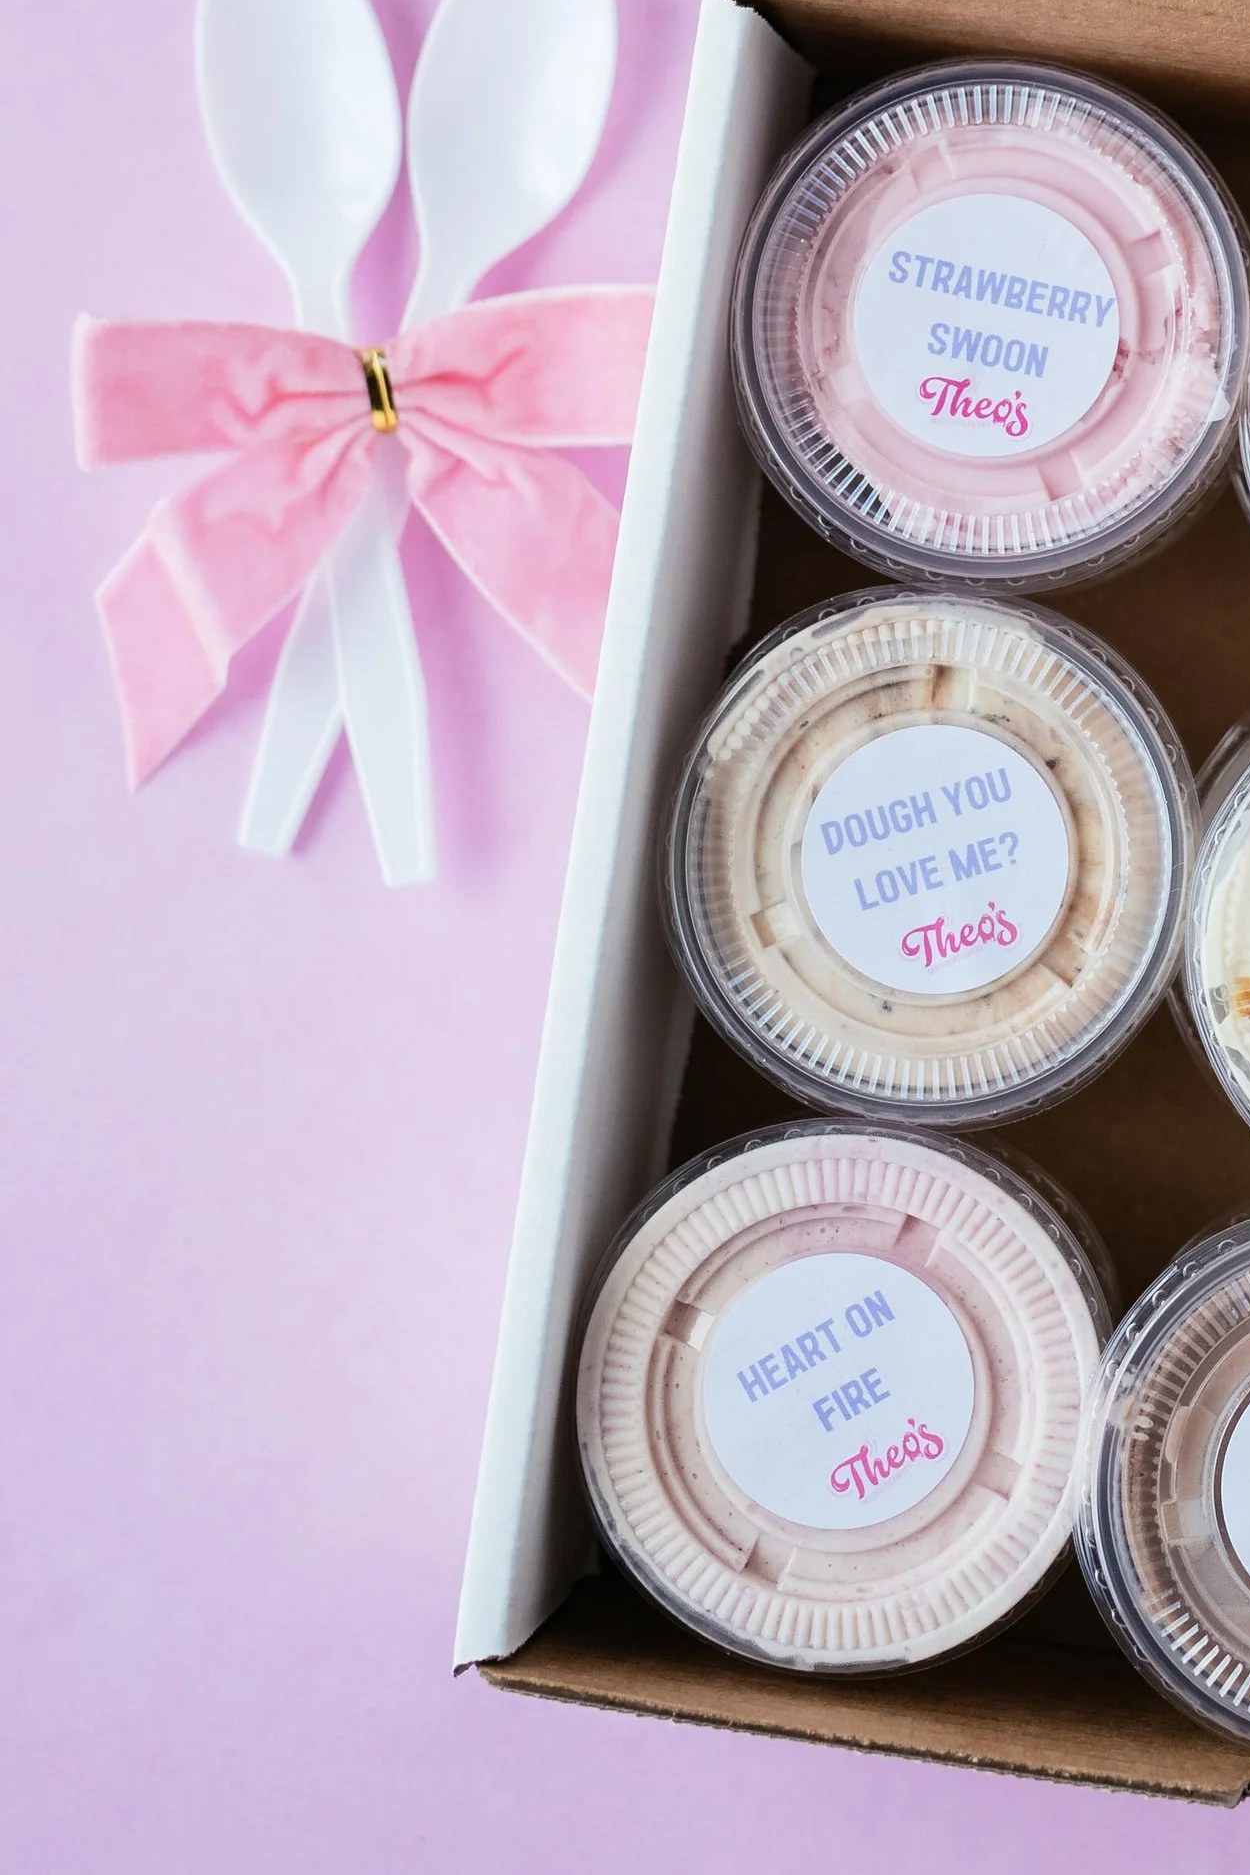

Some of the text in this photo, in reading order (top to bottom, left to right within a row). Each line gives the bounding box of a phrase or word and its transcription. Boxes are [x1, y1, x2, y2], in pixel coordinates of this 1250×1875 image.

[888, 250, 1115, 328] STRAWBERRY
[925, 321, 1049, 378] SWOON
[919, 375, 1029, 438] Theo's
[819, 768, 1012, 857] DOUGH YOU
[853, 831, 1020, 911] LOVE ME?
[900, 901, 1017, 966] Theo's
[737, 1289, 896, 1404] HEART ON
[811, 1367, 892, 1434] FIRE
[830, 1418, 943, 1502] Theo's
